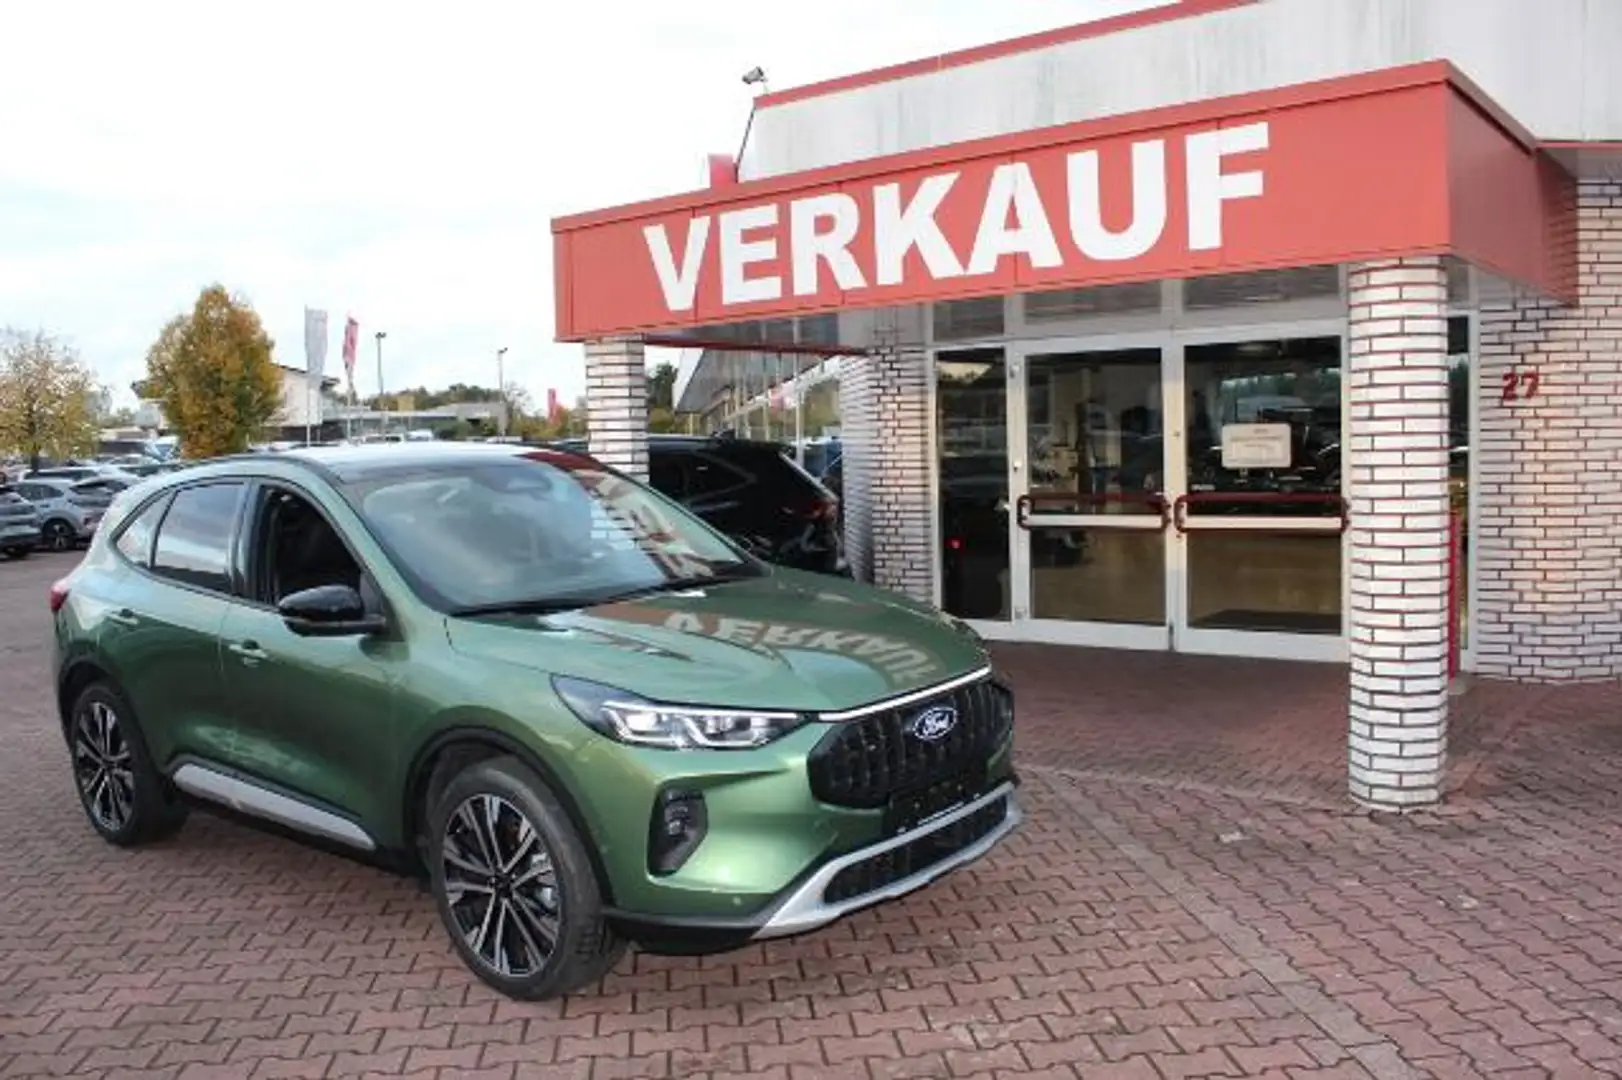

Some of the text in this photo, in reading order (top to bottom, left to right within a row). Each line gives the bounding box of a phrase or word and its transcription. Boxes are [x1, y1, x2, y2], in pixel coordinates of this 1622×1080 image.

[644, 121, 1270, 312] VERKAUF
[1502, 371, 1539, 401] 27
[919, 710, 952, 736] Ford
